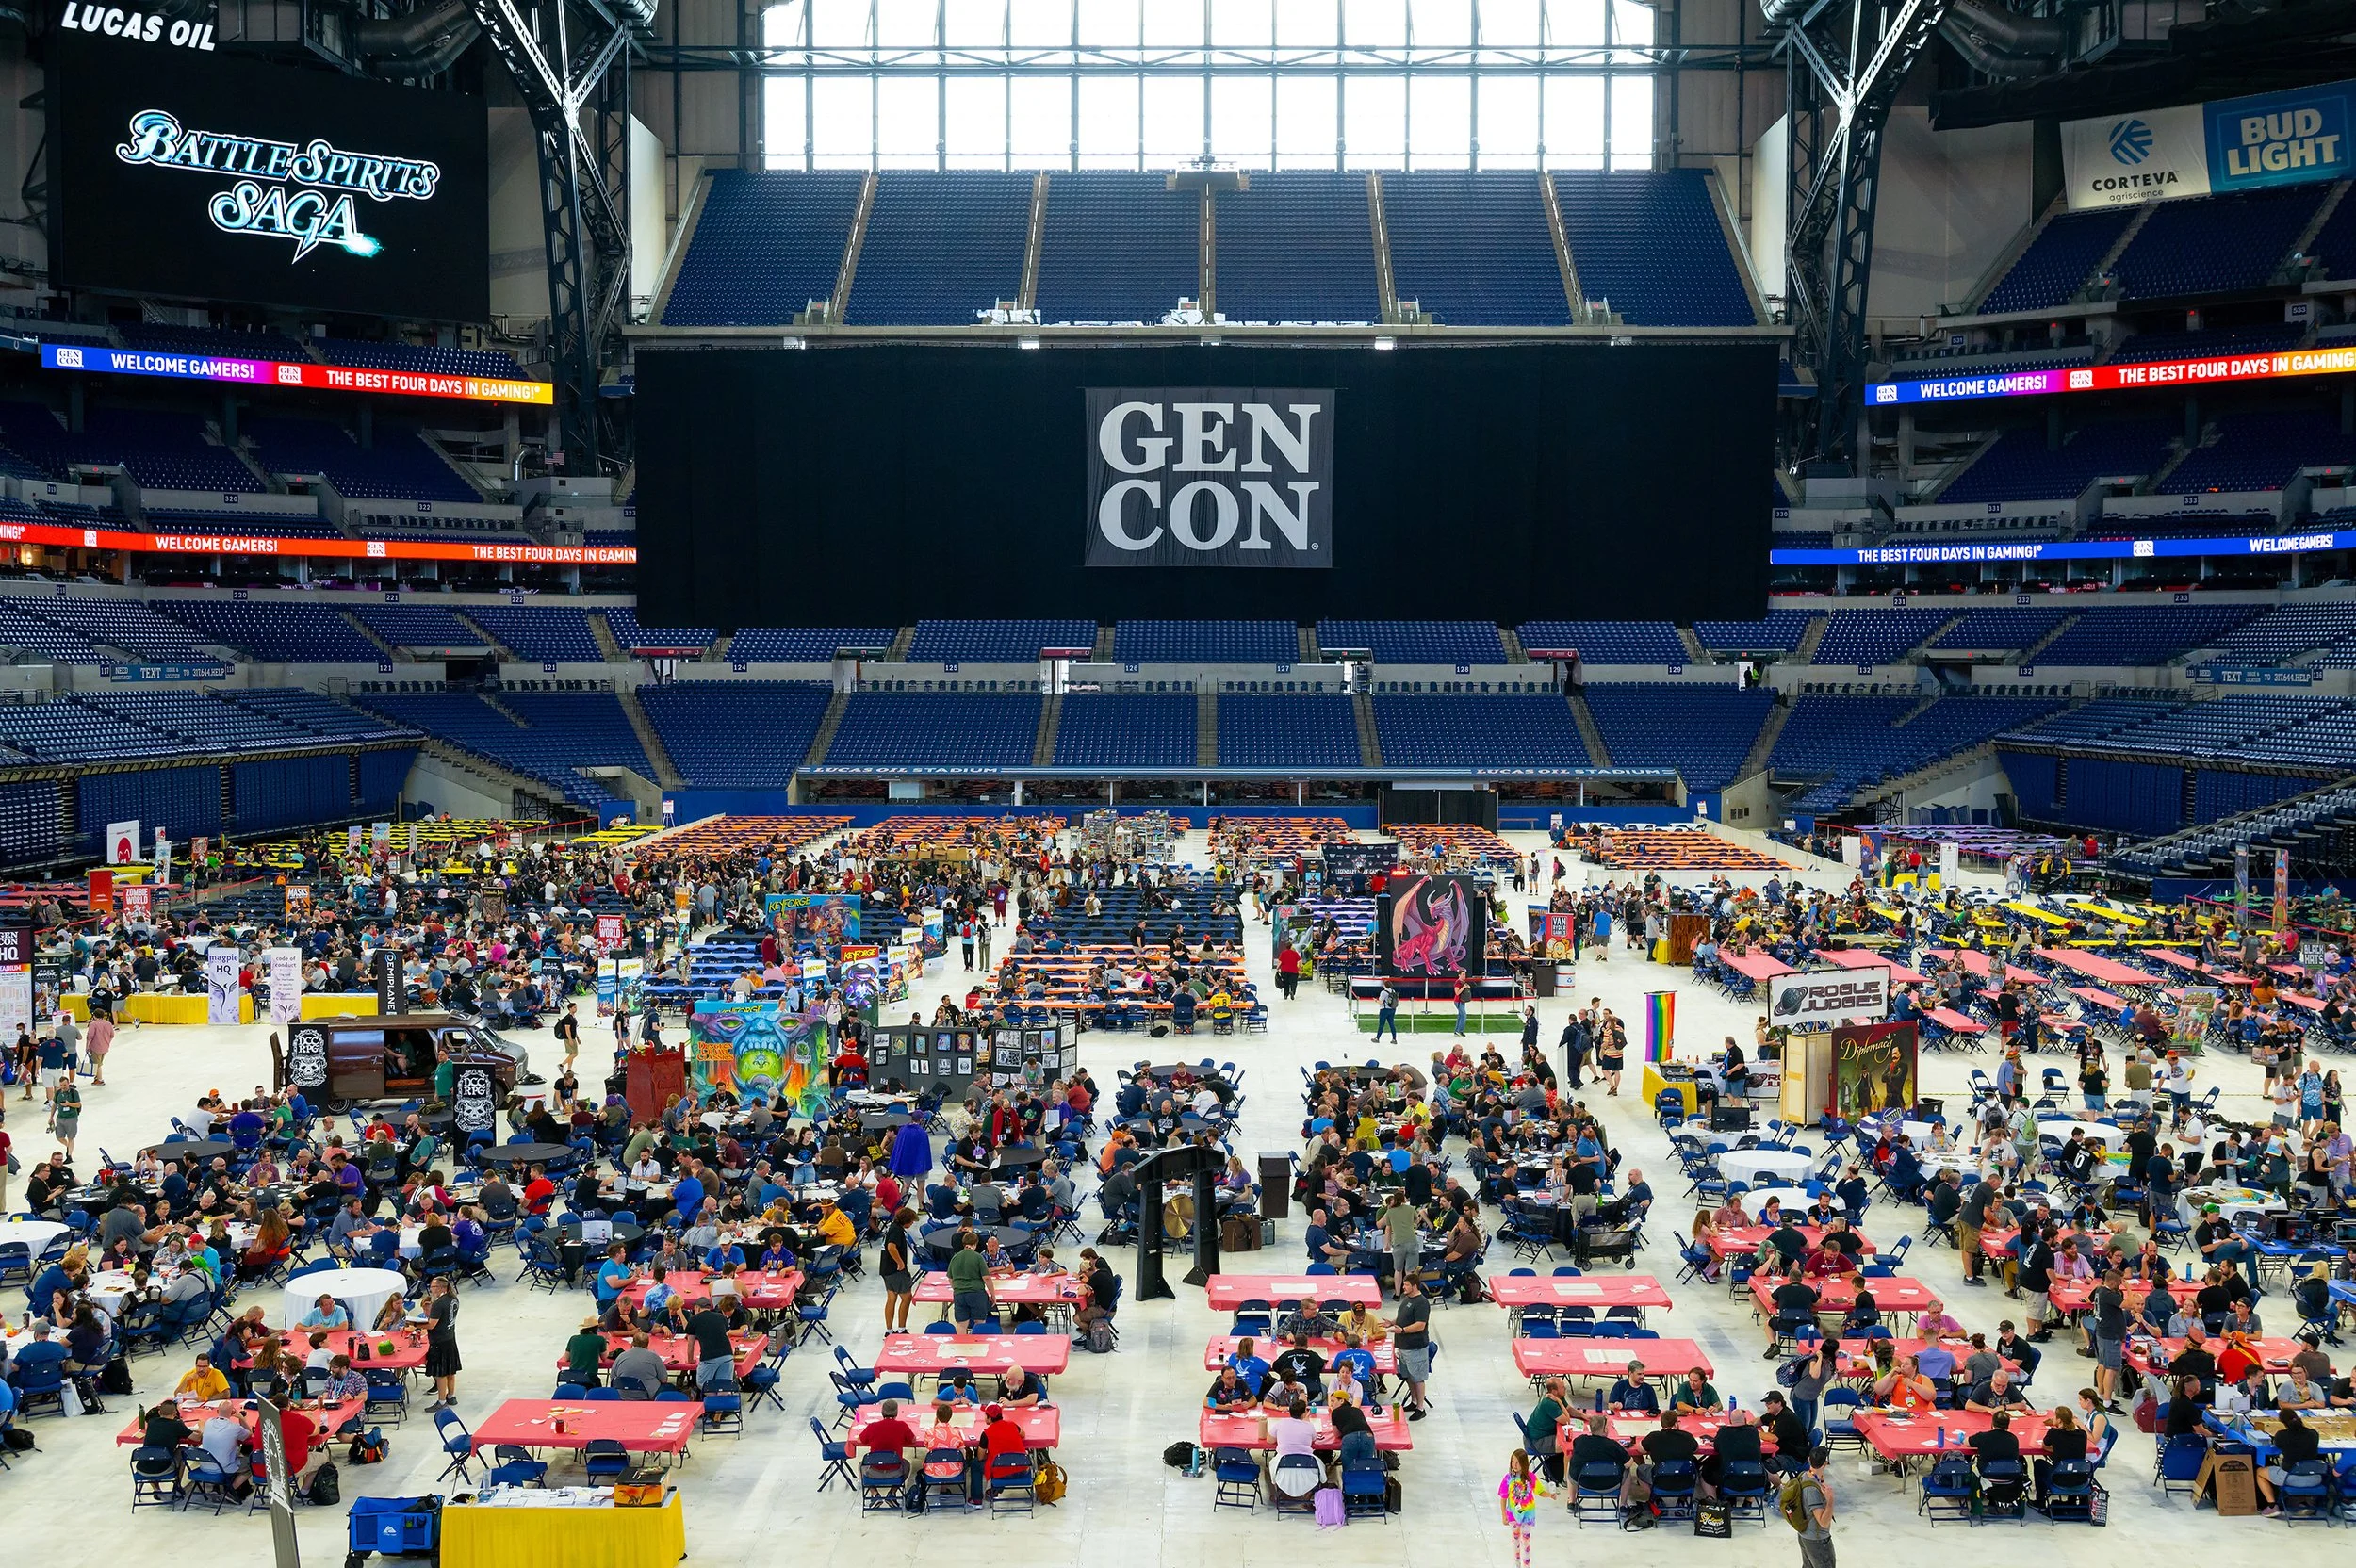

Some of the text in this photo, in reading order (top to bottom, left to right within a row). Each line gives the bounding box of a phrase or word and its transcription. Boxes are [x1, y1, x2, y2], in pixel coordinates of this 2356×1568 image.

[60, 2, 216, 51] LUCAS OIL
[2240, 108, 2324, 146] BUD
[116, 109, 440, 201] BATTLE SPIRITS
[2227, 135, 2340, 176] LIGHT
[2092, 172, 2177, 192] CORTEVA
[2108, 188, 2164, 204] agriscience
[209, 180, 366, 264] SAGA
[59, 350, 80, 359] GEN
[111, 353, 254, 379] WELCOME GAMERS!
[280, 367, 300, 375] GEN
[2119, 367, 2146, 384] THE
[2149, 364, 2186, 383] BEST
[2187, 361, 2228, 380] FOUR
[2231, 358, 2270, 376] DAYS
[2272, 356, 2288, 373] IN
[326, 370, 352, 386] THE
[355, 372, 388, 389] BEST
[392, 375, 427, 392] FOUR
[430, 378, 463, 395] DAYS
[465, 381, 479, 395] IN
[1920, 374, 2047, 399] WELCOME GAMERS!
[1098, 401, 1321, 473] GEN
[224, 495, 237, 503] 320
[2184, 497, 2198, 505] 333
[418, 503, 431, 512] 322
[624, 509, 636, 517] 323
[1775, 510, 1789, 518] 330
[155, 535, 278, 552] WELCOME GAMERS!
[2249, 533, 2333, 552] WELCOME GAMERS!
[473, 546, 494, 559] THE
[496, 547, 522, 560] BEST
[525, 547, 553, 561] FOUR
[555, 548, 581, 562] DAYS
[584, 548, 597, 562] IN
[1857, 549, 1878, 563] THE
[1881, 547, 1907, 562] BEST
[1910, 547, 1940, 561] FOUR
[1942, 546, 1971, 560] DAYS
[1972, 546, 1985, 559] IN
[234, 591, 247, 599] 220
[511, 596, 523, 604] 222
[1893, 597, 1906, 606] 231
[140, 668, 162, 679] TEXT
[183, 668, 190, 677] TO
[1124, 664, 1138, 673] 126
[1276, 664, 1290, 673] 127
[1456, 665, 1470, 674] 128
[1668, 665, 1682, 675] 129
[1858, 665, 1872, 675] 132
[2019, 666, 2033, 676] 132
[2221, 671, 2243, 682] TEXT
[2264, 673, 2271, 681] TO
[125, 888, 149, 897] ZOMBIE
[287, 888, 308, 899] MASKS
[125, 895, 149, 906] WORLD
[768, 896, 811, 916] KEYFORGE
[598, 918, 621, 928] ZOMBIE
[1552, 917, 1566, 925] VAN
[599, 927, 621, 938] WORLD
[843, 946, 877, 964] KEYFORGE
[2303, 944, 2325, 955] BLACK
[209, 953, 238, 963] magpie
[2304, 954, 2325, 965] HATS
[216, 965, 232, 976] HQ
[384, 952, 397, 1010] DEMIPLANE
[1808, 981, 1881, 998] ROGUE
[1802, 994, 1883, 1013] JUDGES
[299, 1037, 319, 1046] DCC
[298, 1044, 319, 1054] RPG
[1840, 1033, 1894, 1066] Diplomacy
[464, 1077, 485, 1086] DCC
[464, 1086, 486, 1095] RPG
[764, 1202, 774, 1211] 26
[583, 1210, 595, 1218] 30
